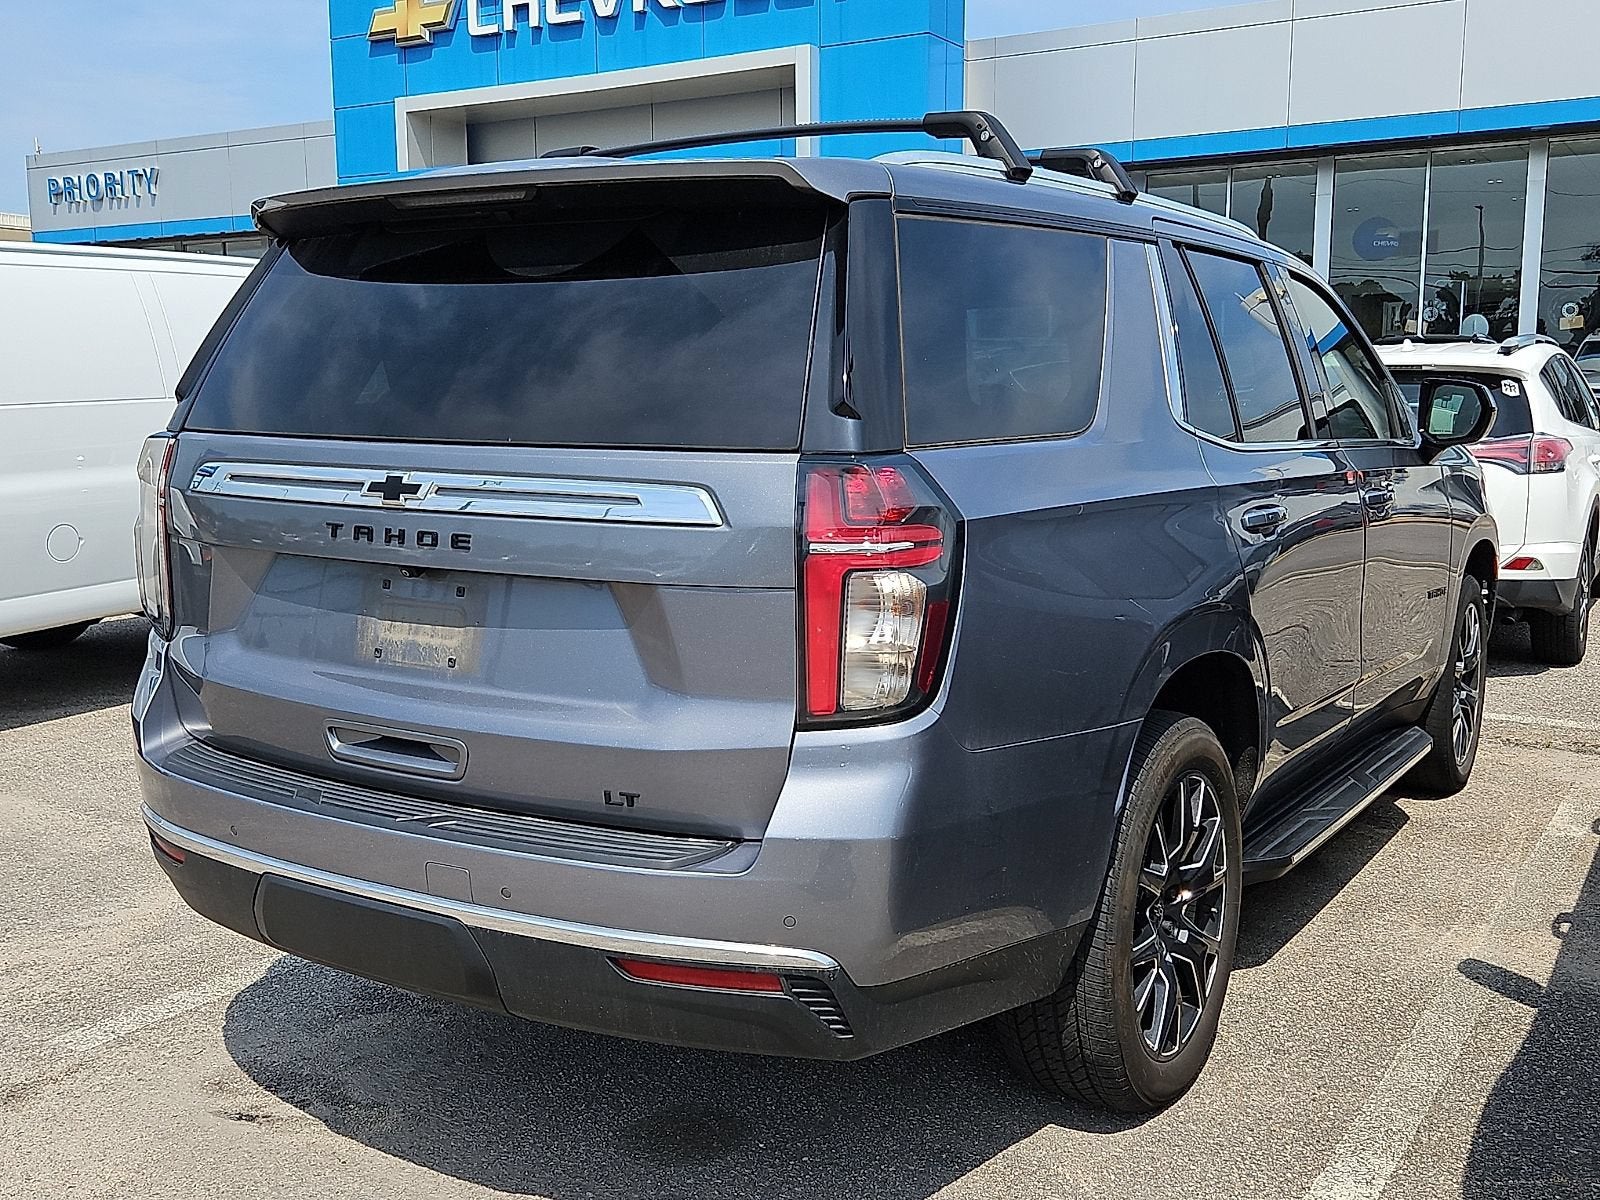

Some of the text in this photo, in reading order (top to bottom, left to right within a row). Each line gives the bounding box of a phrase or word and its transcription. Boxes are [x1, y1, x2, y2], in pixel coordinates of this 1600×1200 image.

[47, 167, 160, 206] PRIORITY
[325, 521, 473, 552] TAHOE
[603, 790, 641, 807] LT
